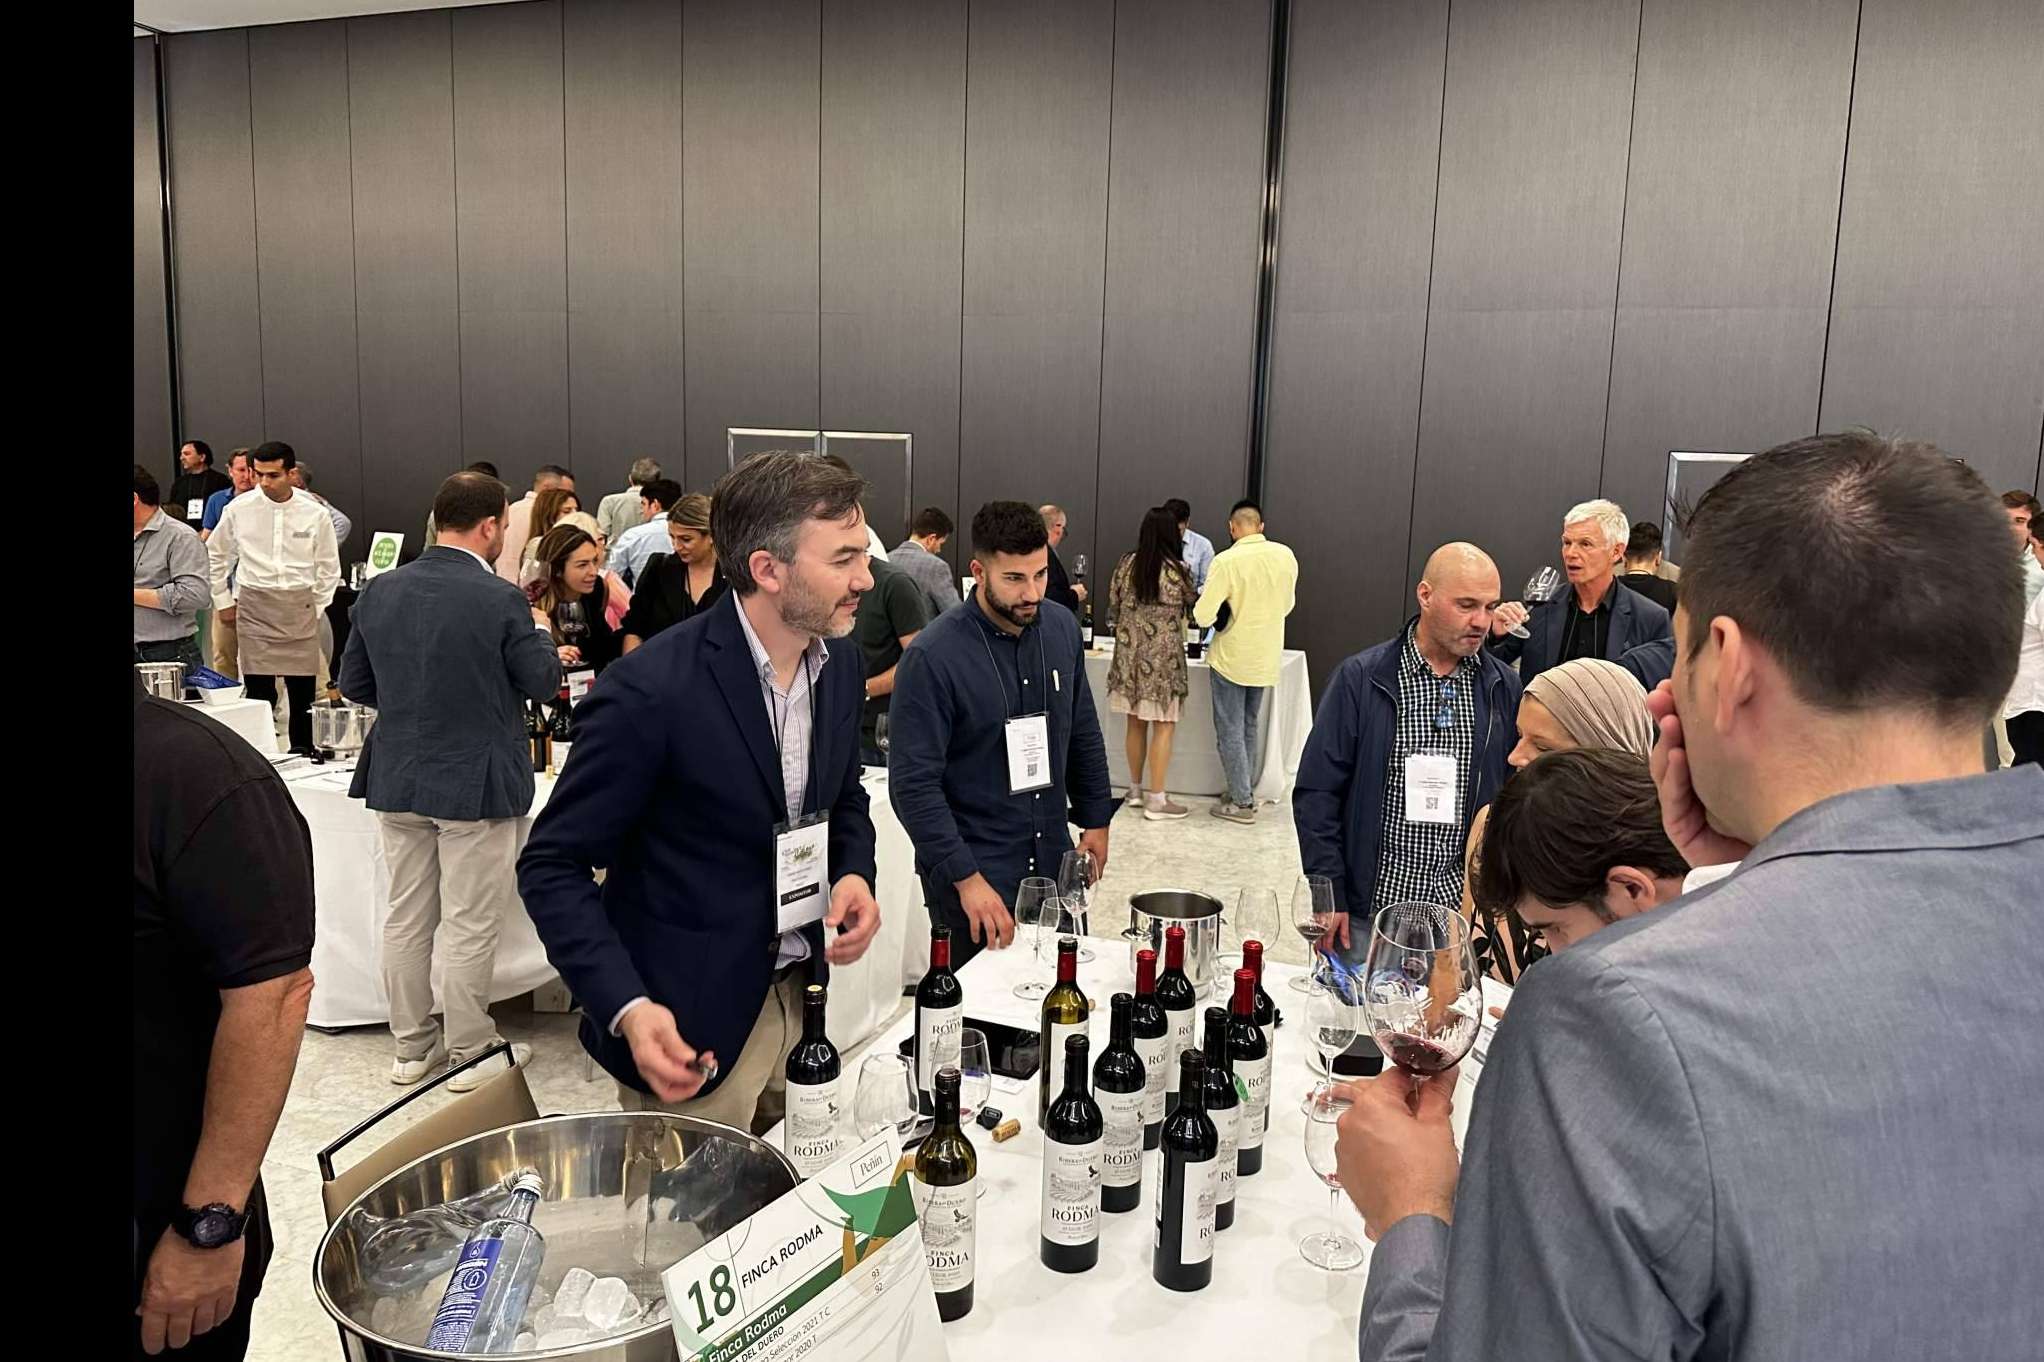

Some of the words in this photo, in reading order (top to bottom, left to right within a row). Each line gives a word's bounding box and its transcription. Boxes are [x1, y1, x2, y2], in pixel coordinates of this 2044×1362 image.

[1103, 1150, 1141, 1166] RODM
[741, 1255, 779, 1289] FINCA
[780, 1224, 824, 1262] RODMA
[926, 1251, 969, 1268] ODMA
[871, 1268, 881, 1280] 93
[874, 1282, 884, 1294] 92
[687, 1264, 737, 1334] 18
[708, 1337, 744, 1362] Finca
[744, 1303, 788, 1342] Rodma
[801, 1316, 819, 1335] 2021
[741, 1348, 758, 1362] DEL
[757, 1325, 785, 1351] DUERO
[795, 1339, 813, 1359] 2020
